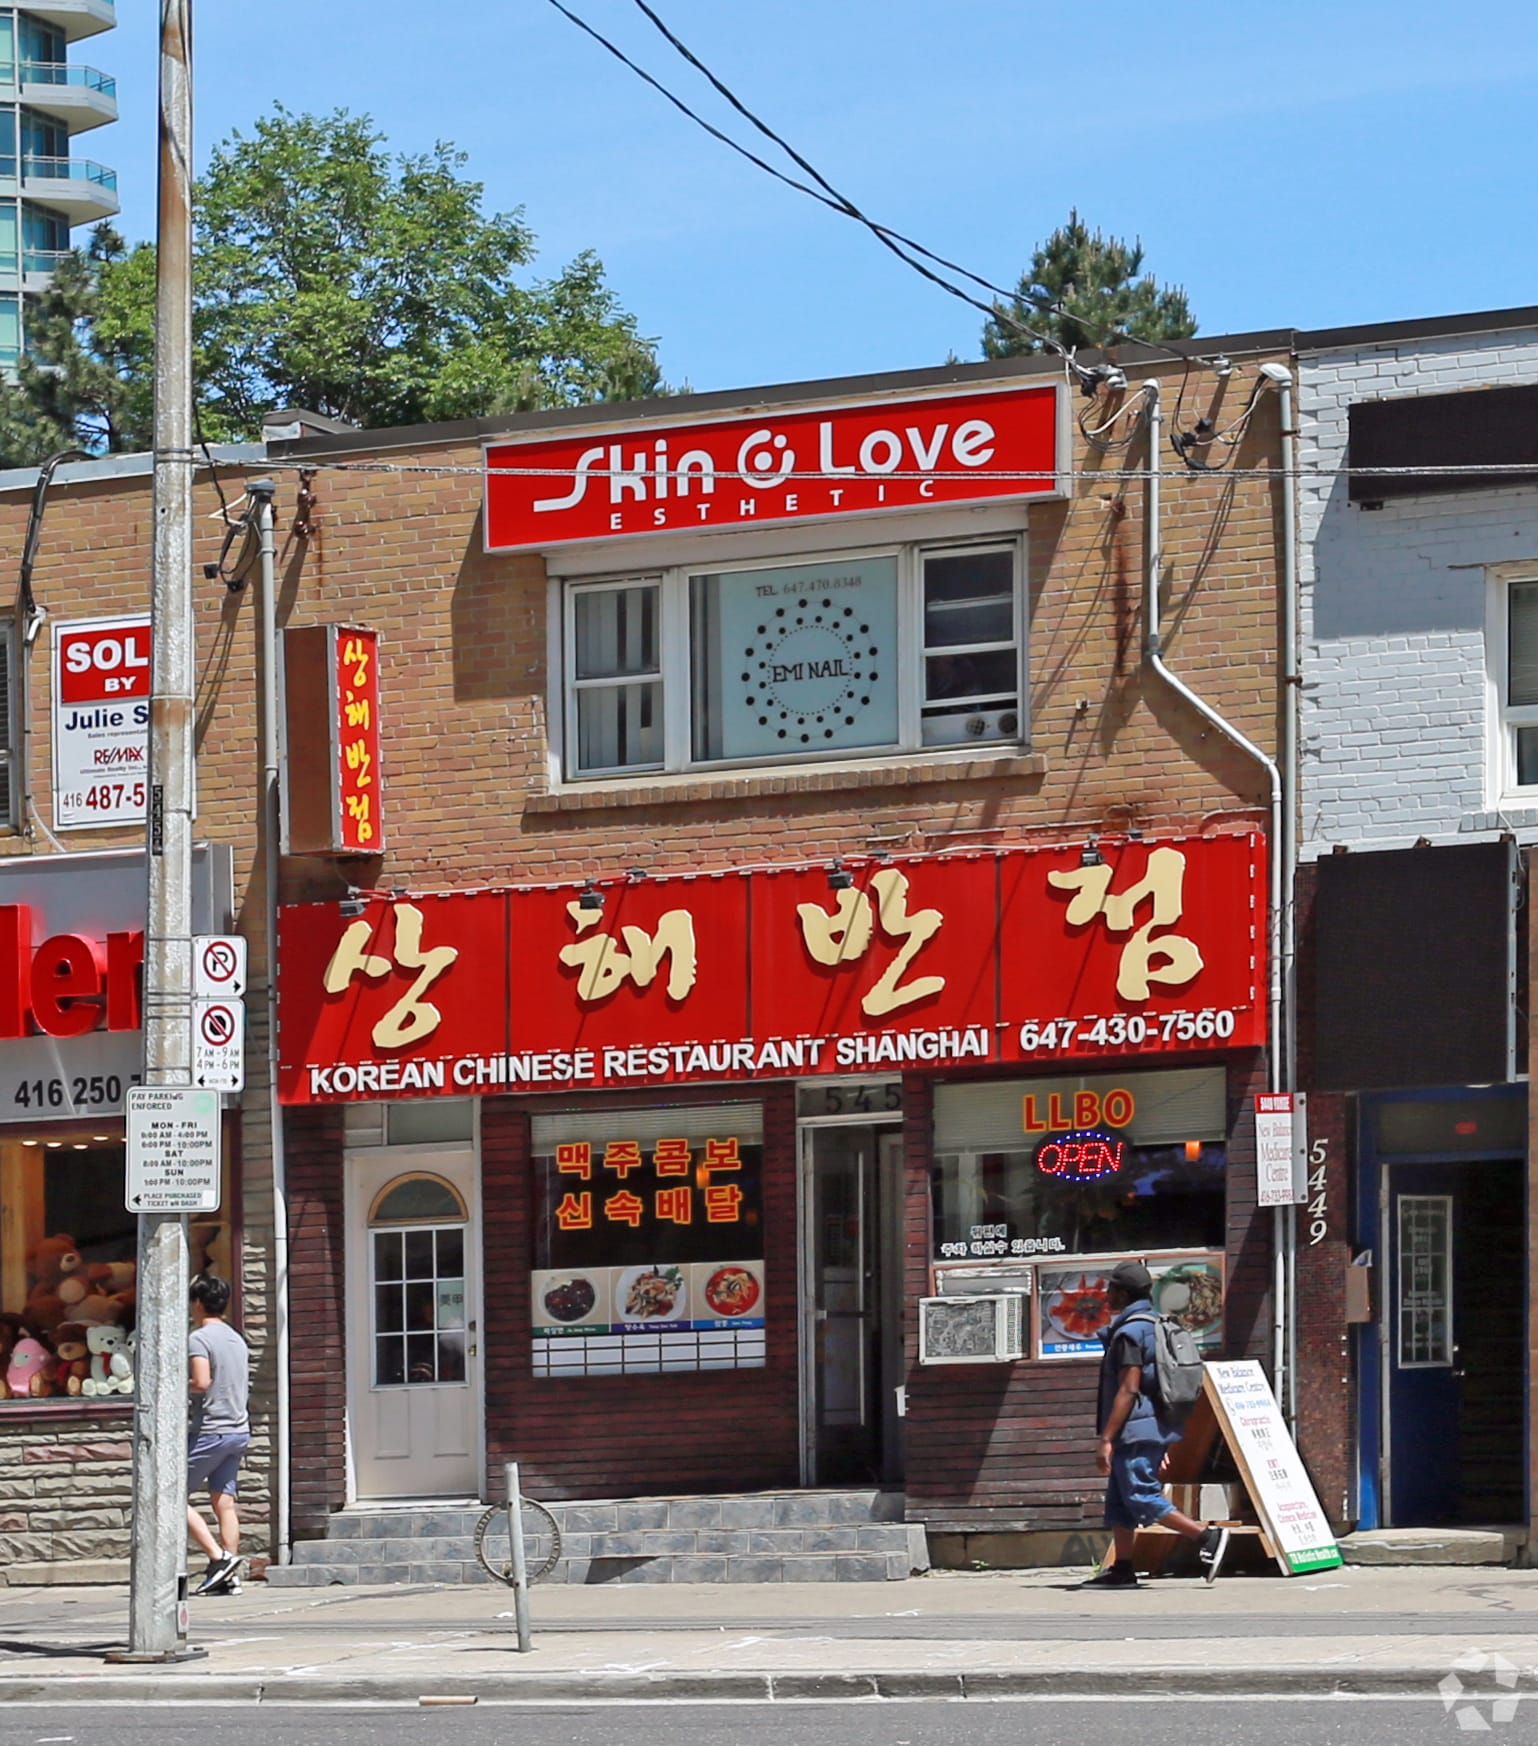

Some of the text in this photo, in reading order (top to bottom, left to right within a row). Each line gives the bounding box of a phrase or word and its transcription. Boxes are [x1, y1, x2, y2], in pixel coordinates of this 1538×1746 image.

[533, 419, 995, 512] Skin Love
[610, 480, 934, 530] ESTHETIC
[808, 659, 849, 680] NAIL
[103, 676, 136, 692] BY
[65, 708, 124, 731] Julie
[94, 745, 144, 765] RE/MAX
[63, 792, 83, 808] 416
[204, 1049, 215, 1057] AM
[230, 1048, 240, 1057] AM
[310, 1010, 1235, 1095] KOREAN CHINESE RESTAURANT SHANGHAI 647-430-7560
[204, 1060, 215, 1069] PM
[230, 1059, 240, 1069] PM
[14, 1081, 63, 1108] 416
[72, 1076, 121, 1107] 250
[131, 1093, 146, 1101] PAY
[131, 1102, 172, 1111] ENFORCED
[1023, 1088, 1135, 1133] LLBO
[151, 1121, 174, 1129] MON
[181, 1121, 198, 1129] FRI
[196, 1130, 208, 1138] PM
[164, 1150, 184, 1158] SAT
[556, 1136, 742, 1181] 맥주콤보
[1037, 1141, 1126, 1174] OPEN
[160, 1159, 172, 1167] AM
[164, 1168, 184, 1176] SUN
[159, 1178, 171, 1186] PM
[1308, 1138, 1329, 1246] 5449
[555, 1184, 744, 1231] 신속배달
[941, 1241, 968, 1257] 주차
